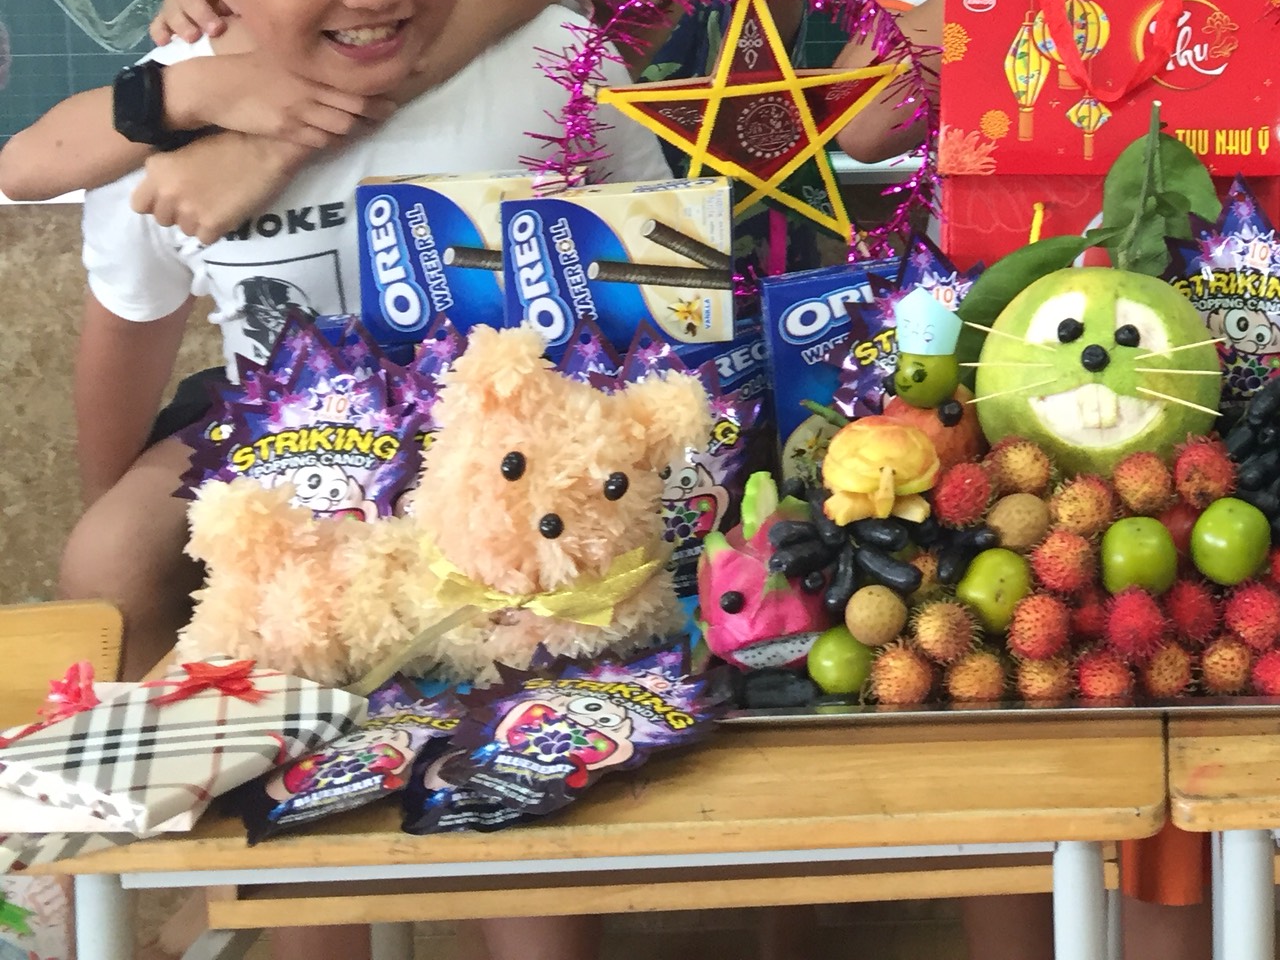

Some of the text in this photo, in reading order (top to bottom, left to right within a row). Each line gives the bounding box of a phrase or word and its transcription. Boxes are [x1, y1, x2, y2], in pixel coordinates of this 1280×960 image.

[367, 198, 424, 328] OREO
[405, 202, 454, 313] WAFER ROLL
[549, 217, 579, 266] ROLL
[1250, 243, 1270, 261] 10
[511, 213, 567, 341] OREO
[323, 394, 349, 415] 10
[231, 426, 400, 472] STRIKING
[253, 452, 377, 479] POPPING CANDY
[523, 678, 696, 731] STRIKING
